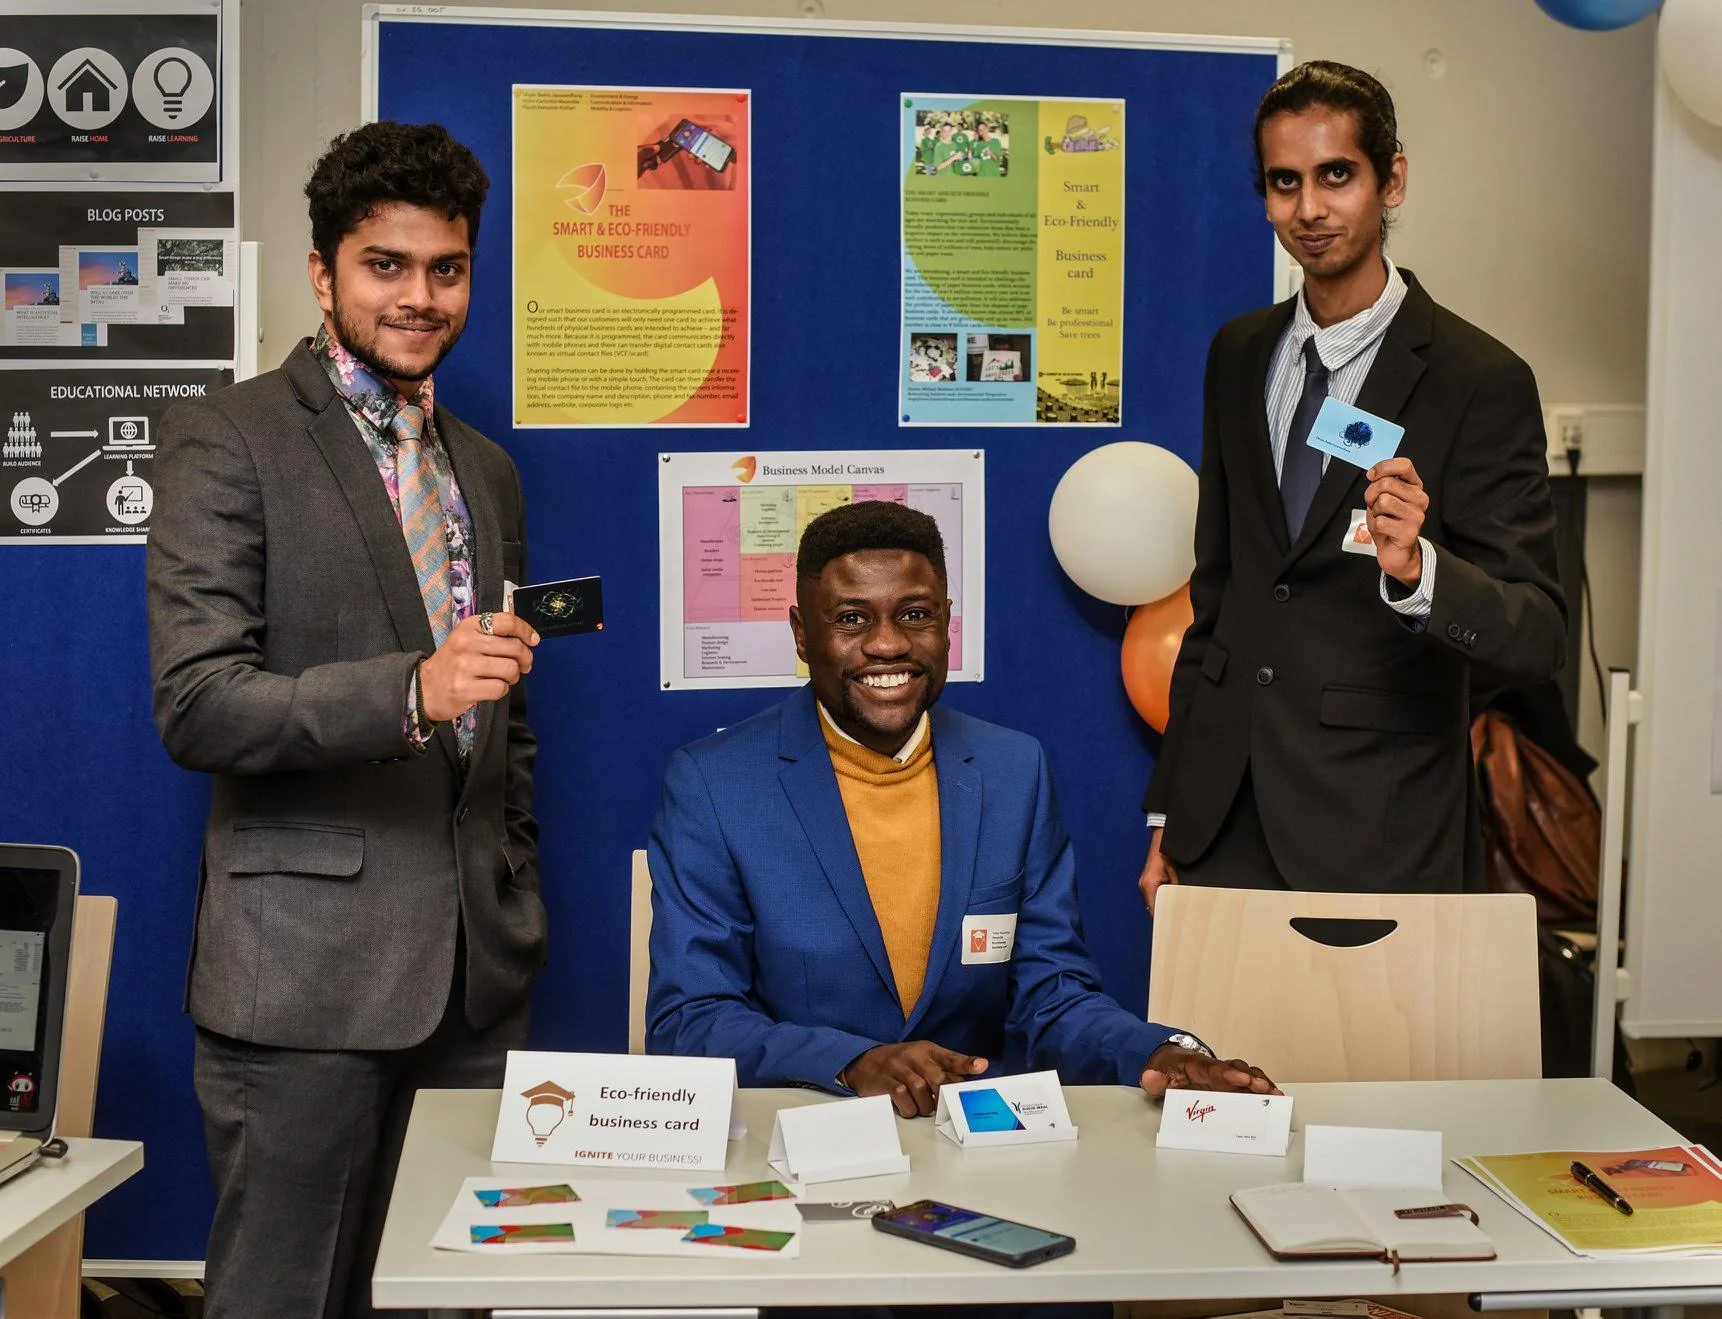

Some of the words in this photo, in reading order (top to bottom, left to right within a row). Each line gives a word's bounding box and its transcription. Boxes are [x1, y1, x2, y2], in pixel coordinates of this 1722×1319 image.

[71, 135, 89, 143] RAISE
[90, 135, 108, 143] HOME
[149, 135, 166, 143] RAISE
[167, 135, 198, 143] LEARNING
[1064, 181, 1100, 192] Smart
[609, 205, 630, 216] THE
[1076, 200, 1086, 210] &
[88, 209, 121, 221] BLOG
[125, 209, 164, 221] POSTS
[553, 222, 594, 236] SMART
[596, 223, 605, 236] &
[608, 223, 690, 236] ECO-FRIENDLY
[1044, 216, 1118, 231] Eco-Friendly
[578, 245, 634, 258] BUSINESS
[637, 246, 670, 259] CARD
[1056, 250, 1107, 262] Business
[1068, 268, 1094, 279] card
[1062, 307, 1072, 315] Be
[1074, 307, 1098, 315] smart
[1048, 319, 1058, 327] Be
[1060, 319, 1114, 330] professional
[1080, 332, 1100, 340] trees
[50, 386, 140, 398] EDUCATIONAL
[143, 385, 206, 398] NETWORK
[762, 464, 808, 476] Business
[811, 464, 844, 475] Model
[847, 463, 885, 475] Canvas
[600, 1086, 696, 1105] Eco-friendly
[1186, 1100, 1216, 1122] Virgin
[589, 1114, 658, 1130] business
[664, 1117, 700, 1131] card
[574, 1150, 614, 1160] IGNITE
[616, 1152, 646, 1162] YOUR
[648, 1153, 702, 1164] BUSINESS!
